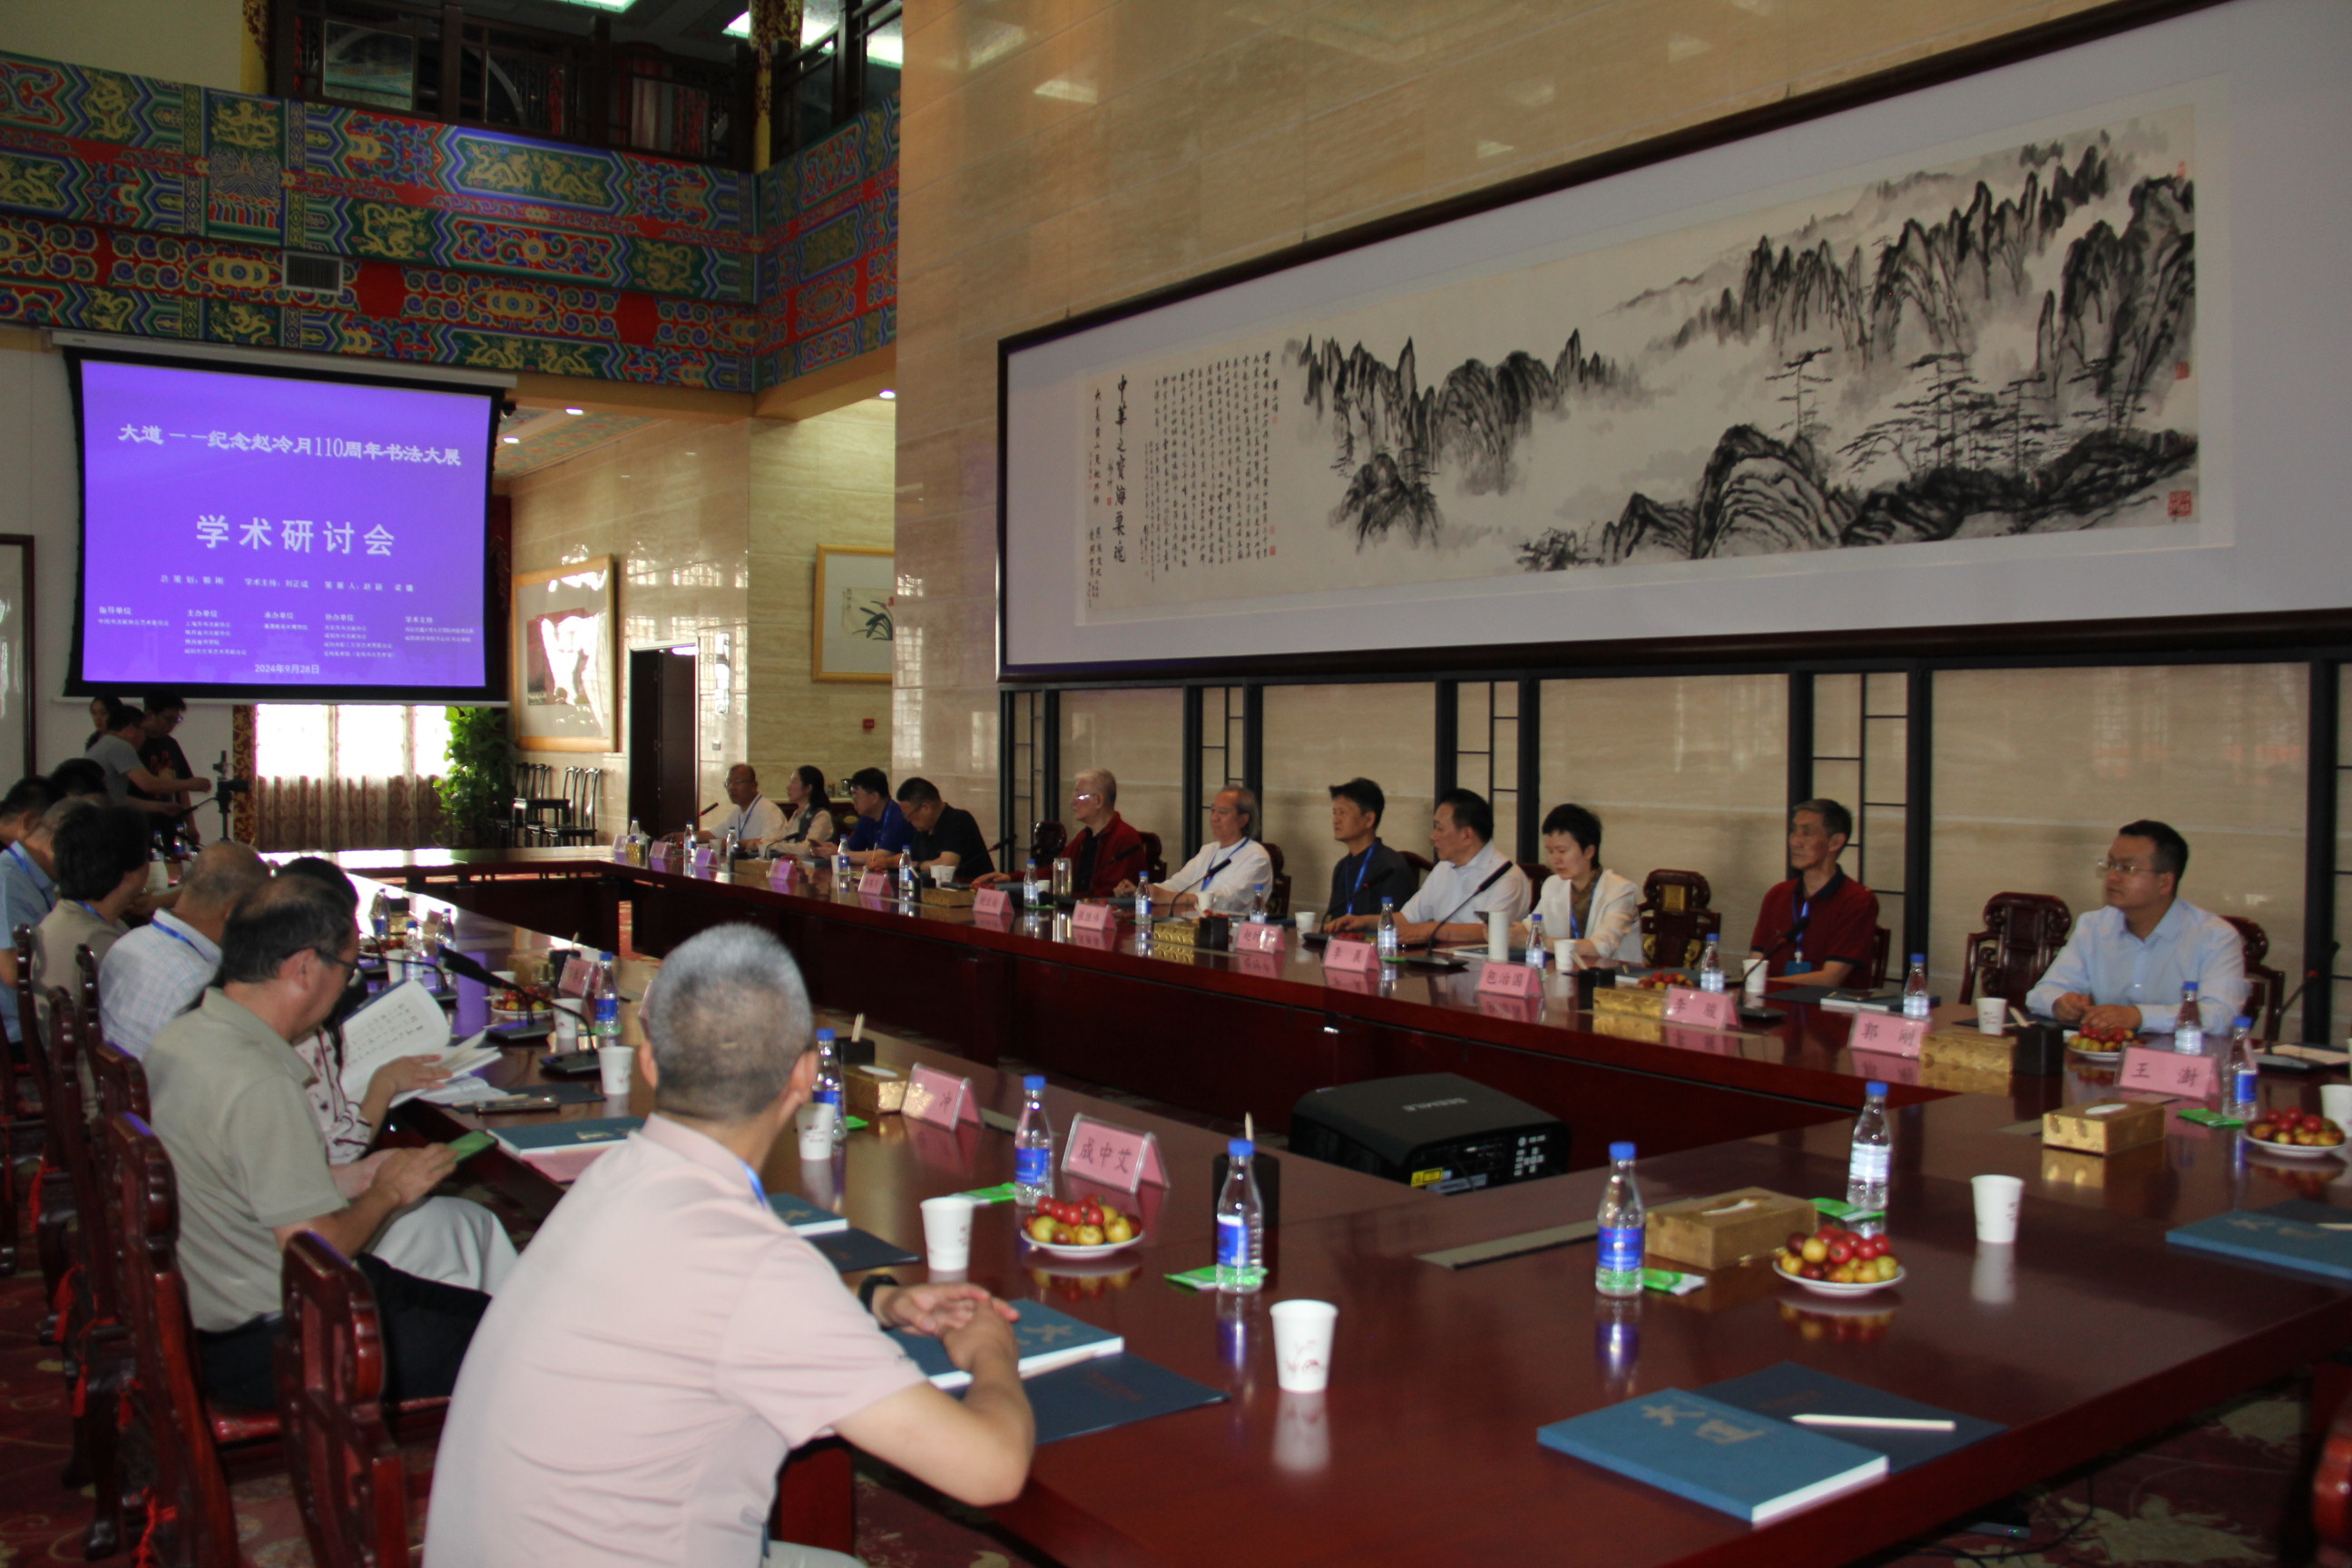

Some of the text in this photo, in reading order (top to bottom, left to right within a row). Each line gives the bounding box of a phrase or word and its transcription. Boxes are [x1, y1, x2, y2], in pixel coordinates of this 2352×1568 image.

[196, 514, 395, 556] 学术研讨会
[255, 663, 319, 673] 2024年9月28日
[1079, 1135, 1134, 1174] 成中艾
